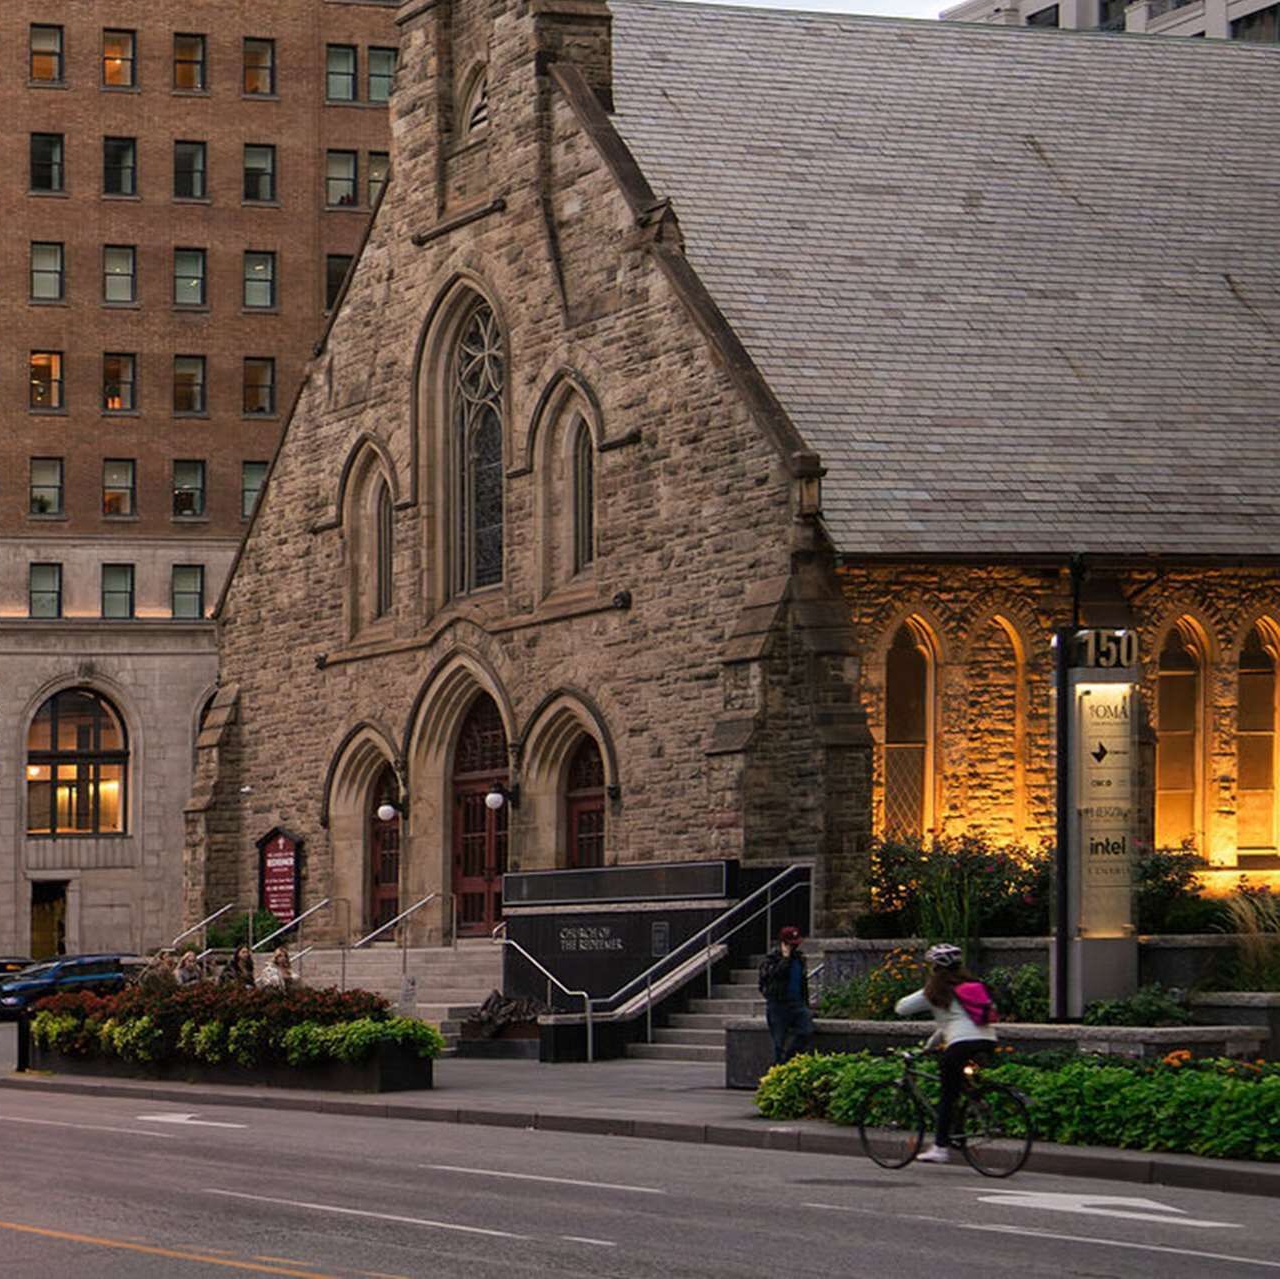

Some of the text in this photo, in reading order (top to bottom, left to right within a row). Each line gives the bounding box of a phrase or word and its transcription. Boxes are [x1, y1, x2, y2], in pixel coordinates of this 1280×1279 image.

[1081, 628, 1138, 667] 150
[1089, 836, 1126, 855] intel
[561, 939, 577, 950] THE
